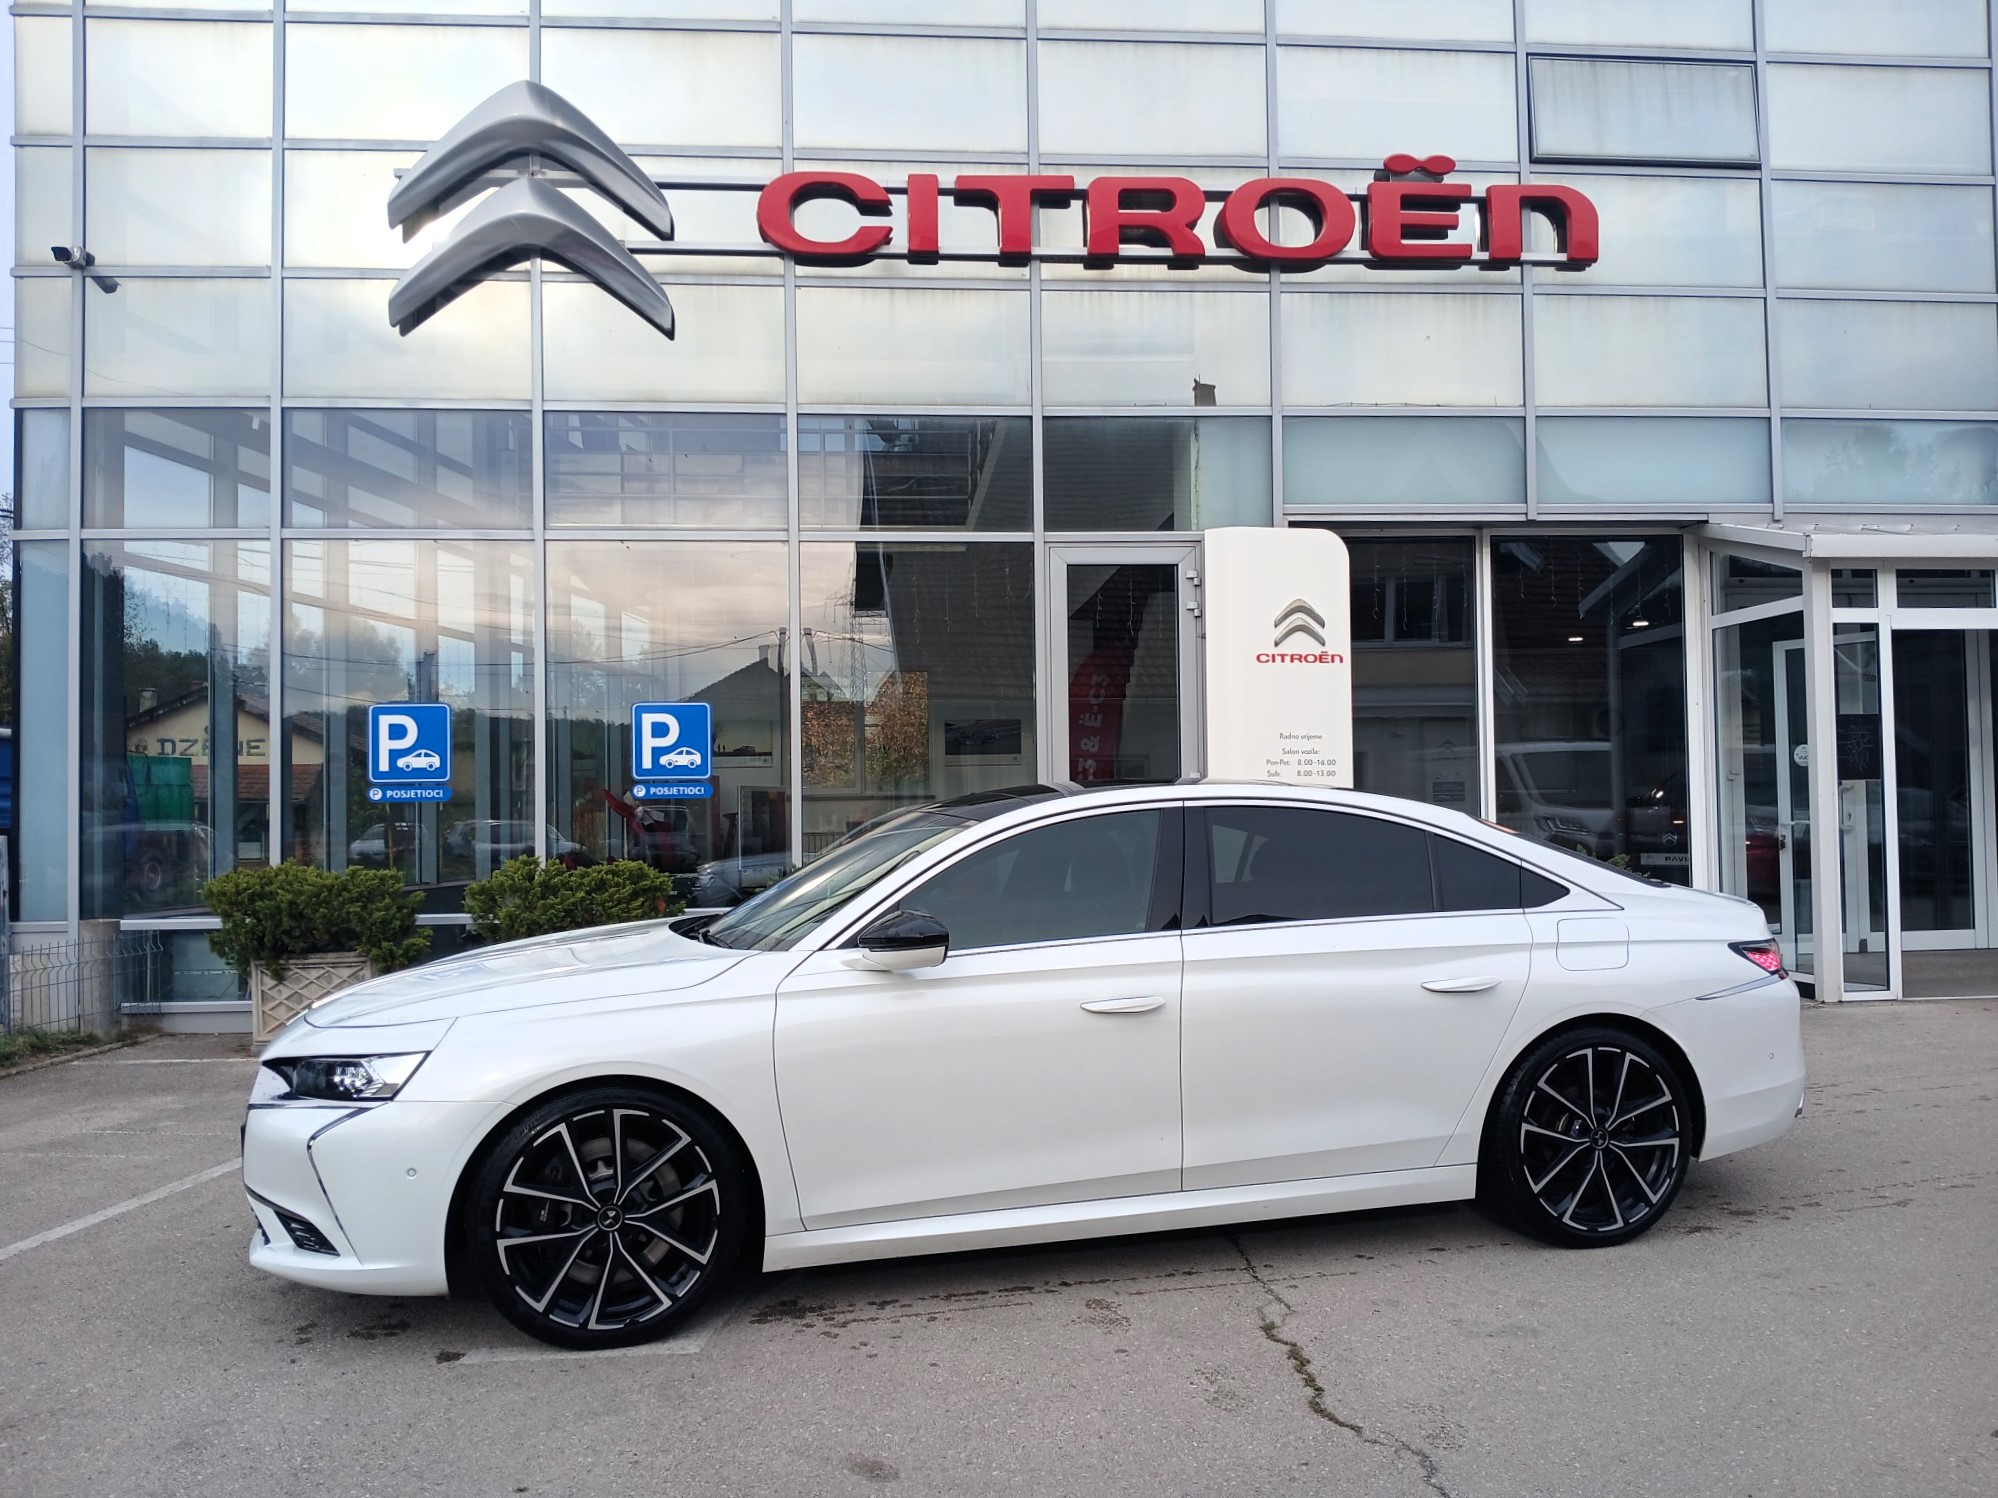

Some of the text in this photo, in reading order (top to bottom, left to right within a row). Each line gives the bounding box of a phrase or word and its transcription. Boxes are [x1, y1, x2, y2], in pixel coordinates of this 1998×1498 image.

[757, 154, 1599, 268] CITROËN
[1256, 651, 1344, 664] CITROËN
[642, 713, 680, 769] P
[1279, 732, 1323, 741] Radno vrijeme
[379, 715, 418, 772] P
[386, 789, 443, 798] POSJETIOCI
[650, 786, 705, 795] POSJETIOCI
